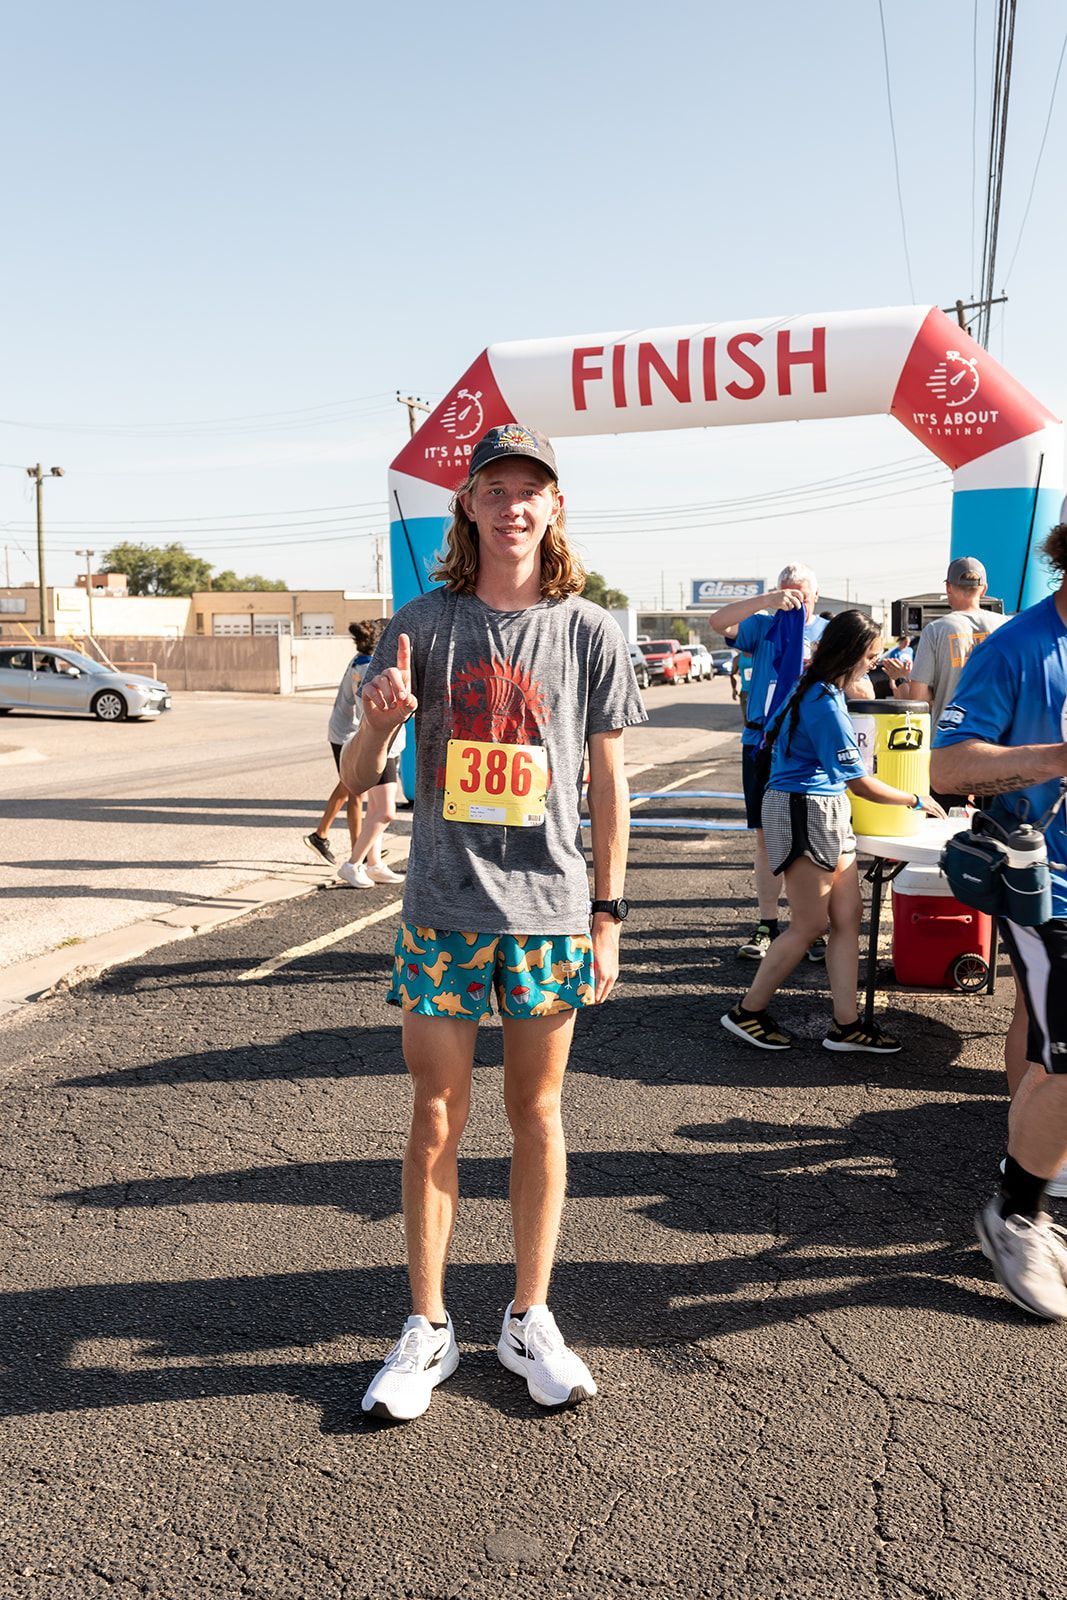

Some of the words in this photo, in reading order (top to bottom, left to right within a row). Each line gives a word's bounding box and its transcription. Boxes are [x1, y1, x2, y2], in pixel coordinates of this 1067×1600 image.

[571, 327, 827, 411] FINISH
[912, 412, 938, 426] IT'S
[943, 410, 999, 425] ABOUT
[928, 426, 983, 436] TIMING
[424, 446, 449, 459] IT'S
[453, 444, 477, 457] AB
[437, 458, 470, 468] TIMI
[698, 581, 760, 596] Glass
[853, 732, 868, 748] R
[459, 747, 533, 797] 386
